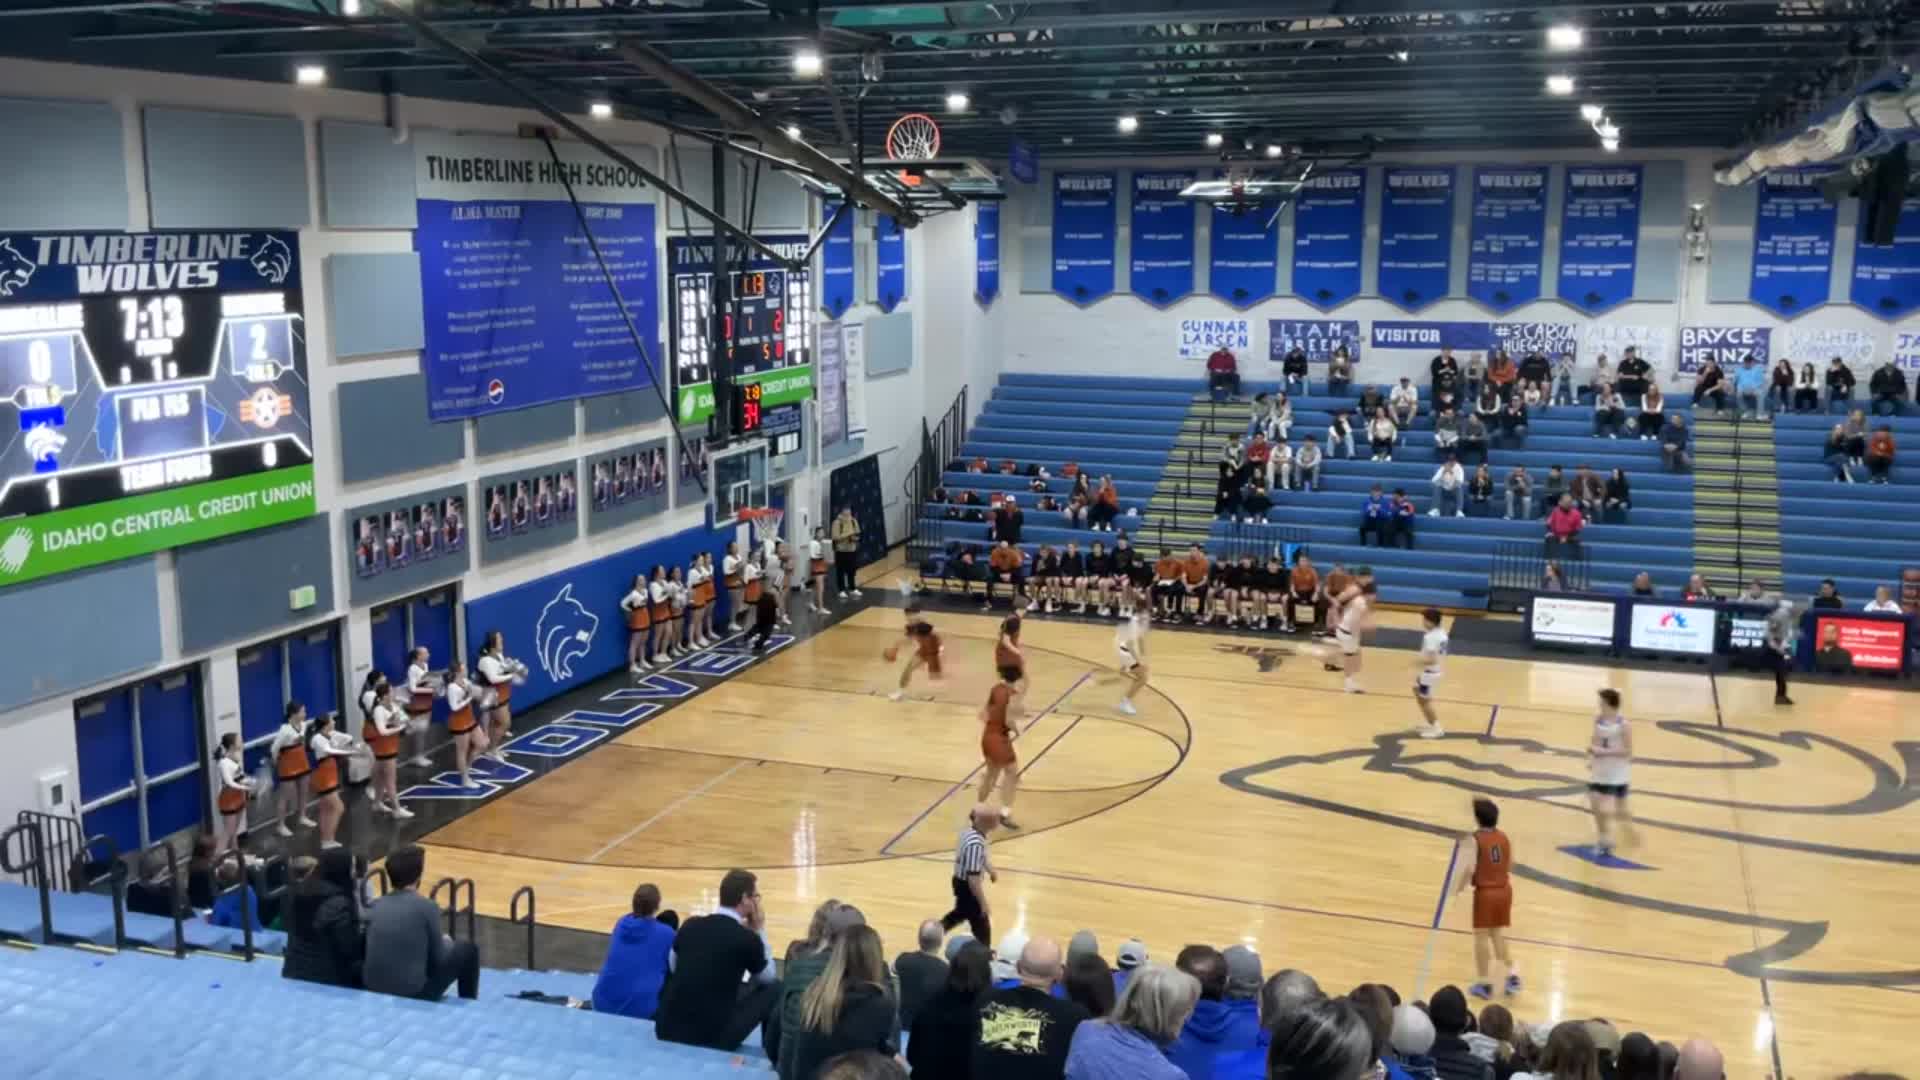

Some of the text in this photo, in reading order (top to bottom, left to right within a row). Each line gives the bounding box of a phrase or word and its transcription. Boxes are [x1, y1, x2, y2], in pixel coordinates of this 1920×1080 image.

[427, 155, 648, 188] TIMBERLINE HIGH SCHOOL
[1570, 173, 1637, 186] WOLVES
[1766, 173, 1814, 185] WOLV
[1059, 178, 1112, 190] WOLVES
[1389, 174, 1449, 187] WOLVES
[1479, 174, 1543, 187] WOLVES
[451, 205, 521, 220] ALMA MATER
[32, 233, 252, 265] TIMBERLINE
[76, 260, 219, 294] WOLVES
[119, 296, 184, 341] 7:13
[1181, 320, 1248, 334] GUNNAR
[1281, 322, 1342, 338] LIAM
[1375, 327, 1441, 343] VISITOR
[1682, 328, 1757, 346] BRYCE
[250, 324, 268, 360] 2
[1183, 333, 1248, 348] LARSEN
[29, 340, 51, 383] 0
[1682, 347, 1752, 364] HEINZ
[743, 402, 759, 429] 34
[42, 480, 313, 553] IDAHO CENTRAL CREDIT UNION
[1492, 844, 1501, 863] 0
